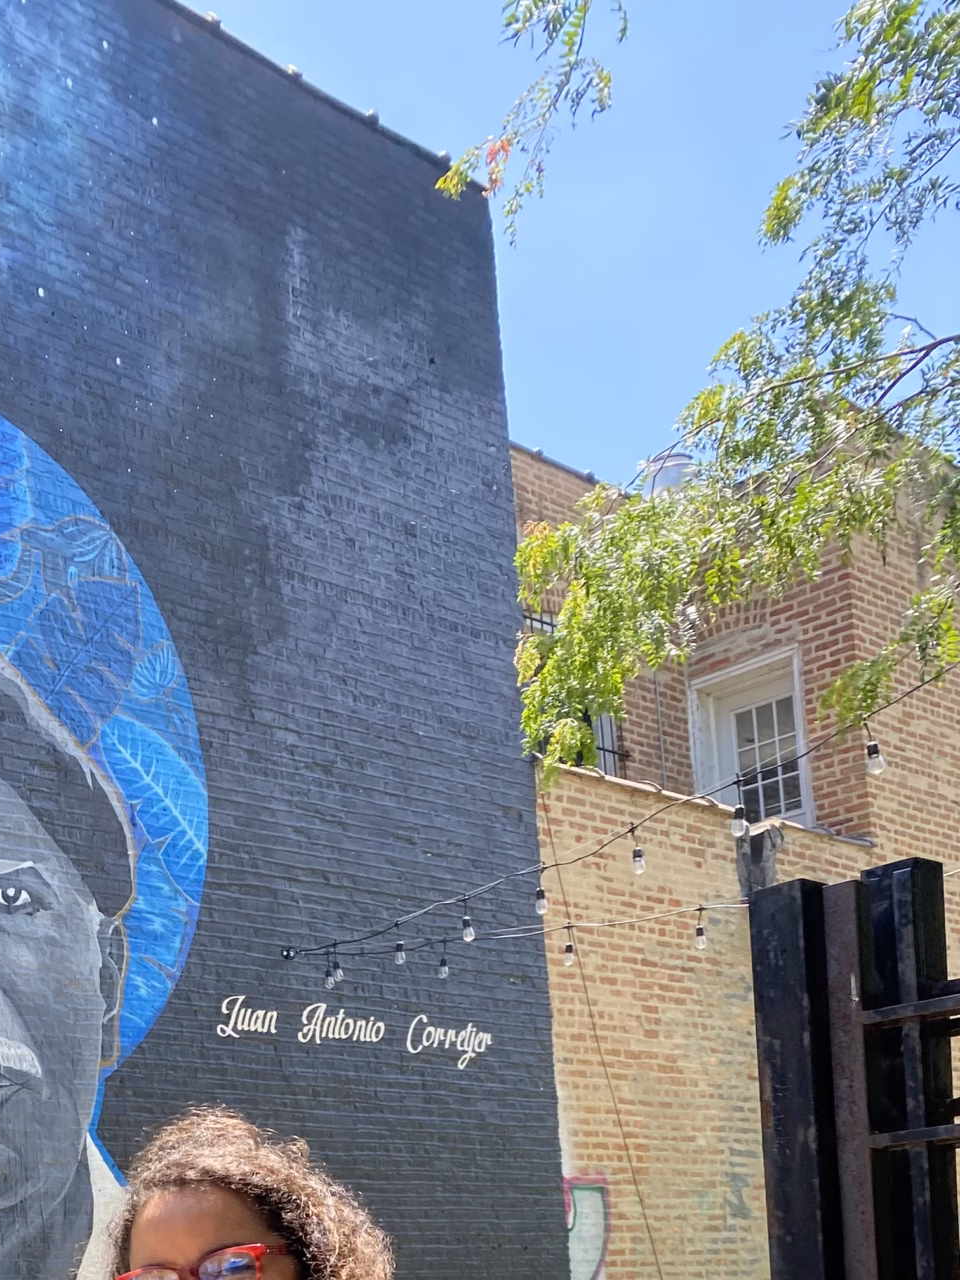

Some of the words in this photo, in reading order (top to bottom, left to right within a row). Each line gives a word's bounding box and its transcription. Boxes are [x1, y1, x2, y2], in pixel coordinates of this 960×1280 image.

[217, 995, 279, 1038] Juan
[298, 1003, 385, 1044] Antonio
[406, 1014, 494, 1070] Corretjer
